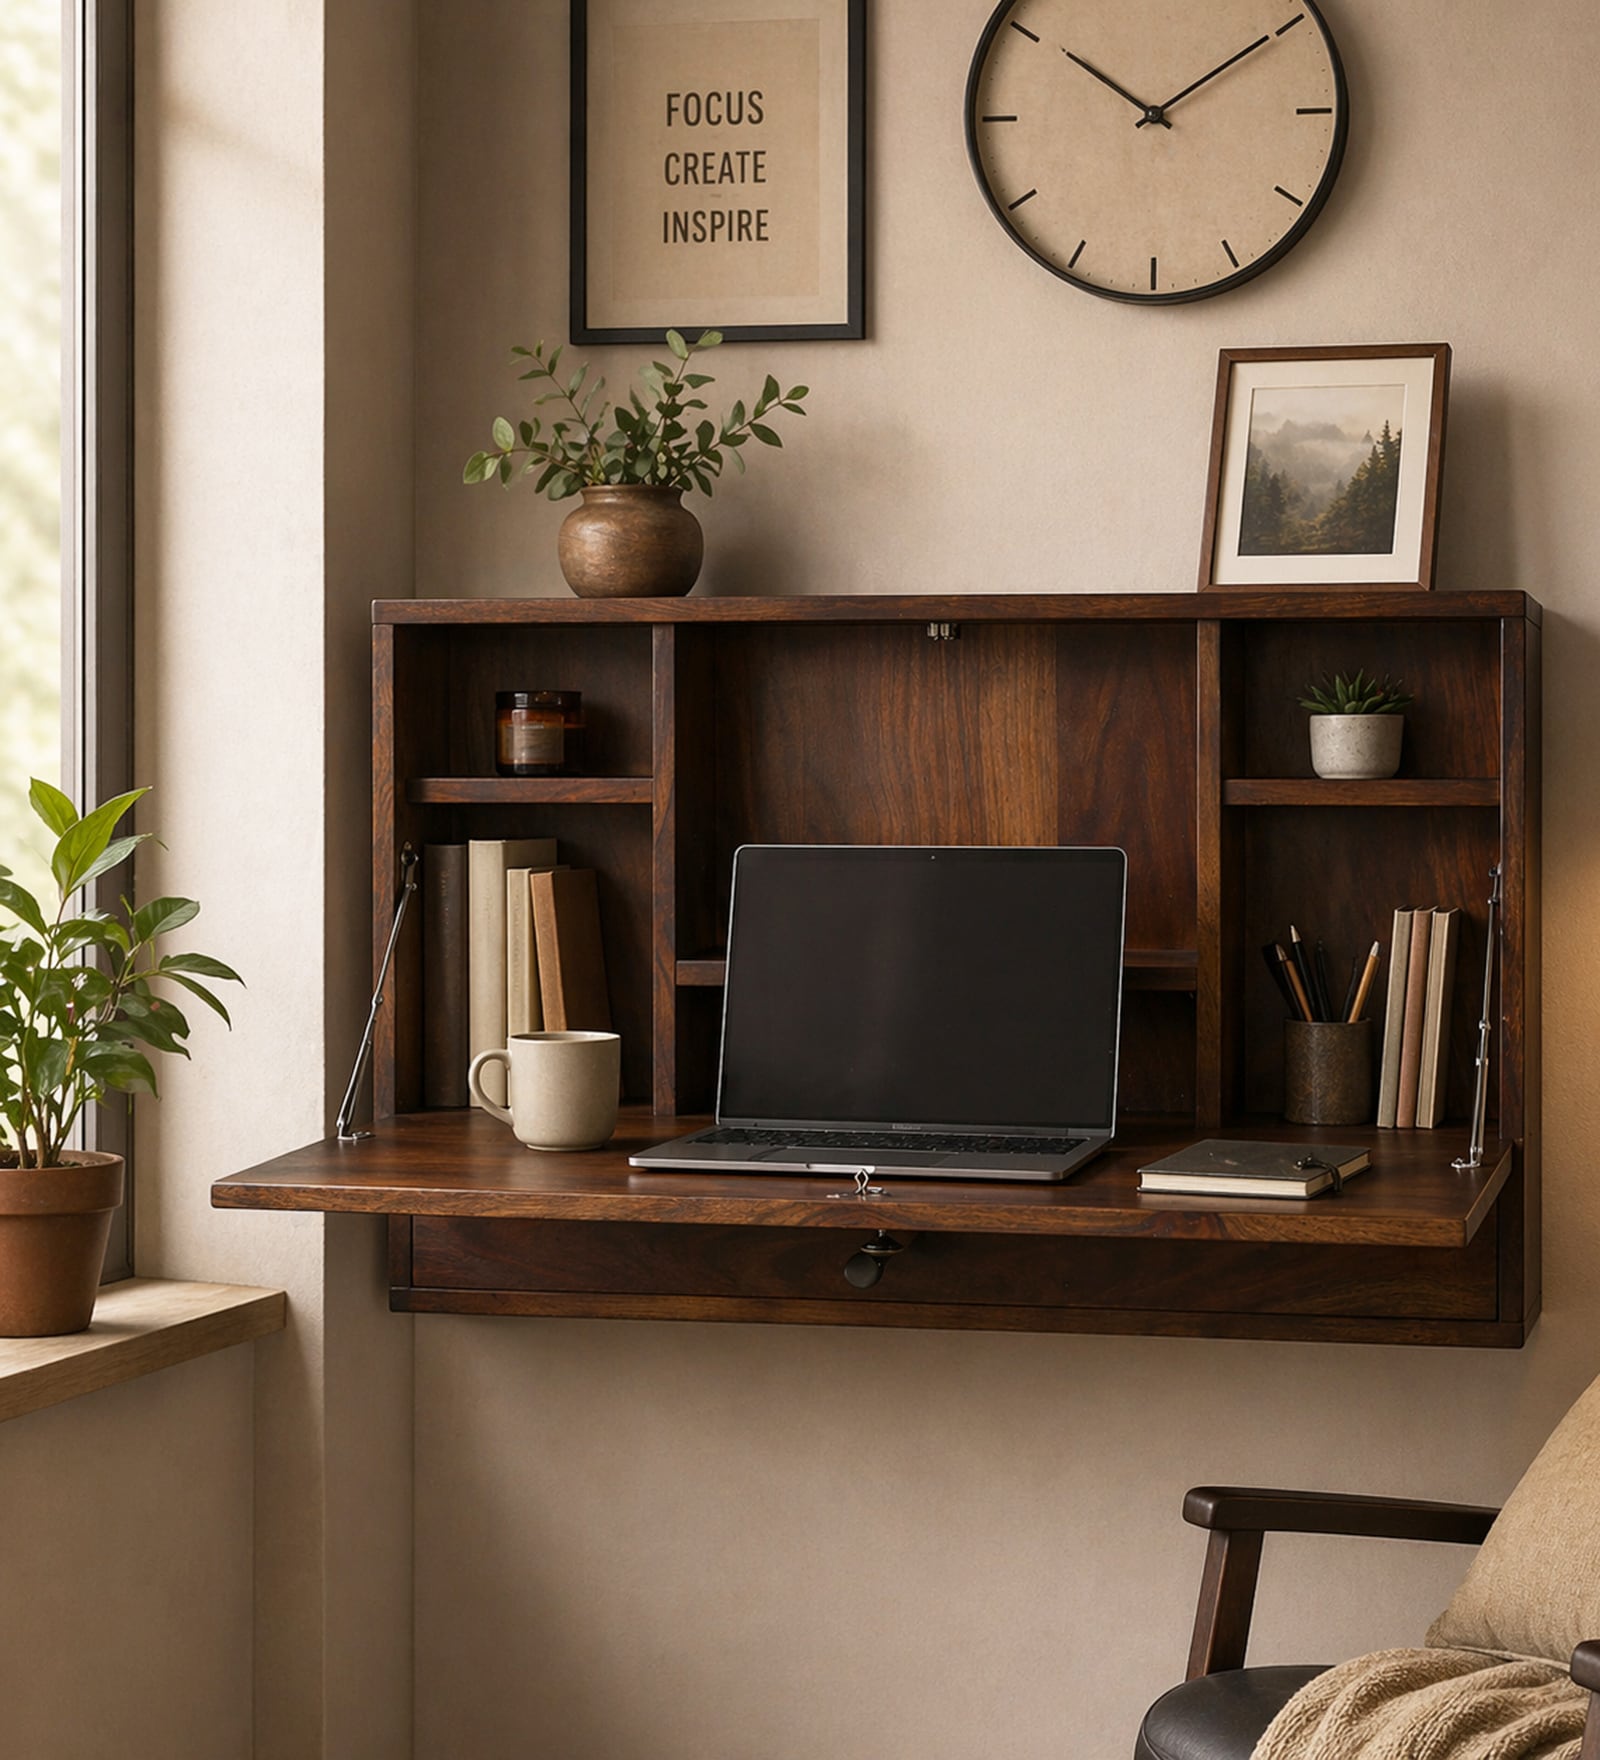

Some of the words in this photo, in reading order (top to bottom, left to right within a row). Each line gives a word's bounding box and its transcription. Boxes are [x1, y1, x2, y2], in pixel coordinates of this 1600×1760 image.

[666, 90, 764, 127] FOCUS
[664, 150, 766, 186] CREATE
[663, 209, 769, 243] INSPIRE
